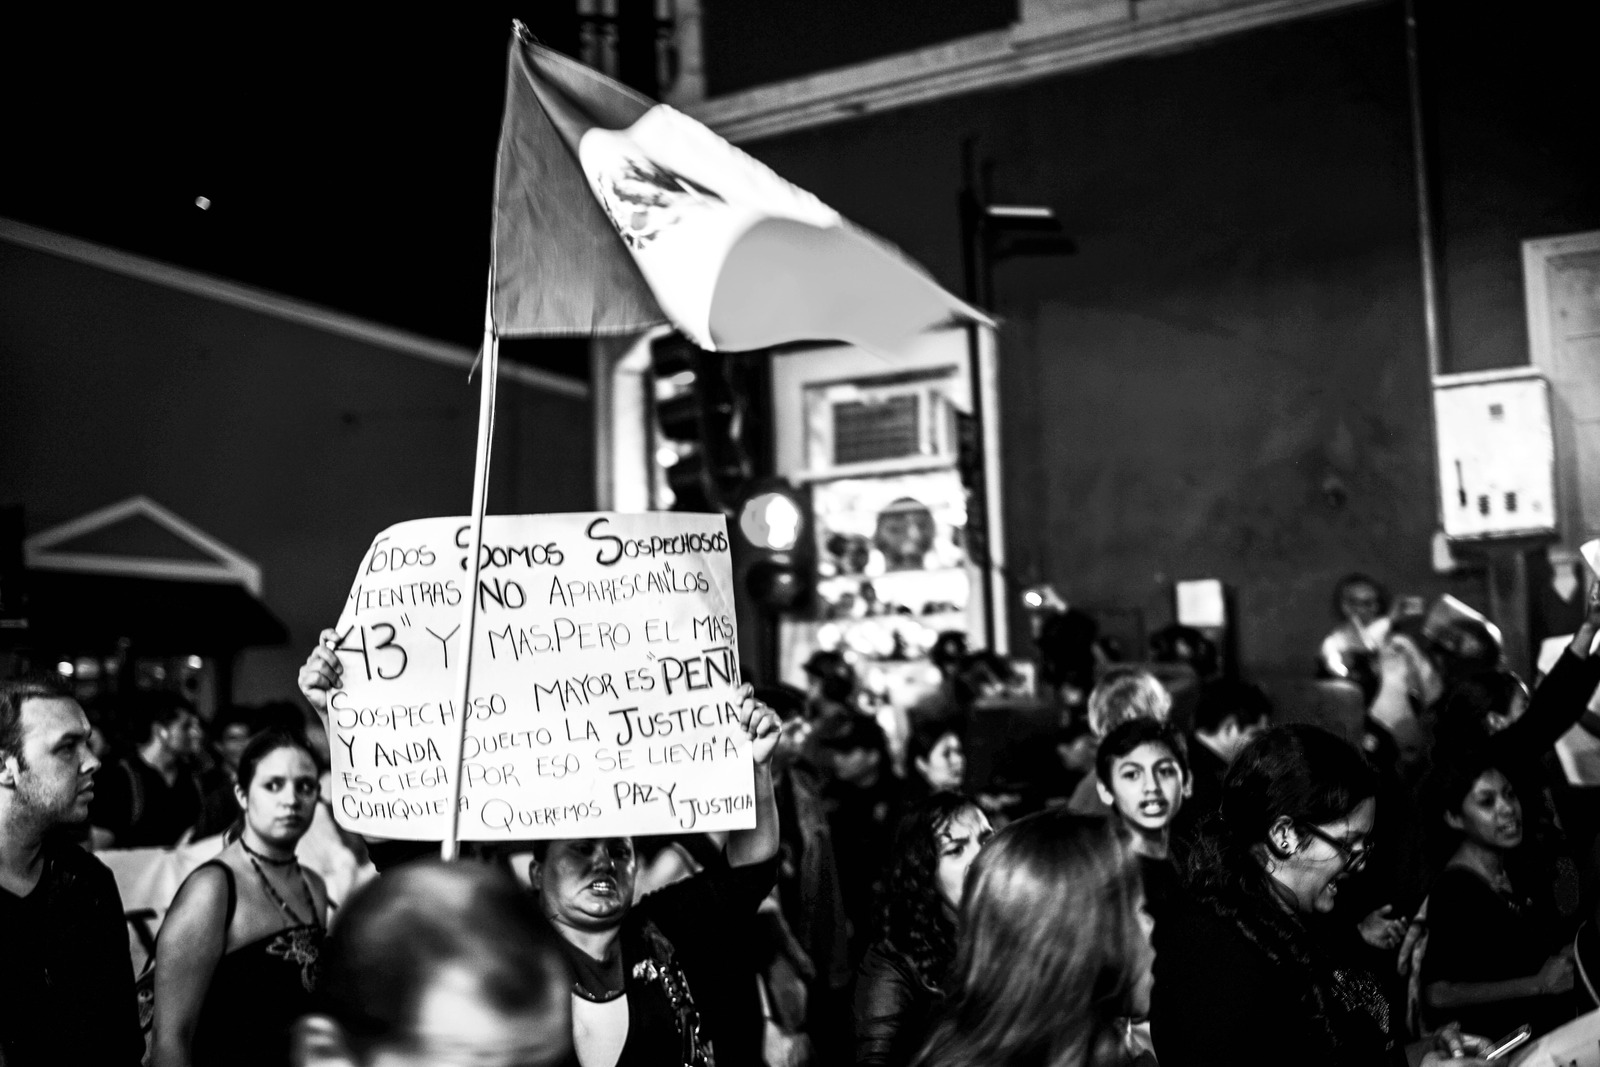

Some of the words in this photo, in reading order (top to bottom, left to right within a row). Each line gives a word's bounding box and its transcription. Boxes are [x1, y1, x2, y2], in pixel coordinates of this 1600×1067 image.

[366, 536, 436, 576] TODOS
[584, 517, 729, 567] SOSPECHOSOS
[479, 577, 526, 613] NO
[425, 623, 461, 669] Y
[645, 618, 679, 643] EL
[693, 614, 734, 641] MAS
[534, 674, 619, 712] MAYOR
[625, 668, 655, 692] ES
[337, 733, 356, 768] Y
[374, 737, 441, 767] ANDA
[565, 718, 600, 742] LA
[608, 701, 740, 746] JUSTICIA
[341, 772, 373, 794] ES
[379, 765, 448, 793] CIEGA
[463, 762, 520, 788] POR
[537, 753, 580, 778] ESO
[595, 748, 635, 772] SE
[481, 798, 602, 832] QUEREMOS
[613, 781, 658, 810] PAZ
[657, 782, 677, 817] Y
[679, 793, 753, 829] JUSTICIA
